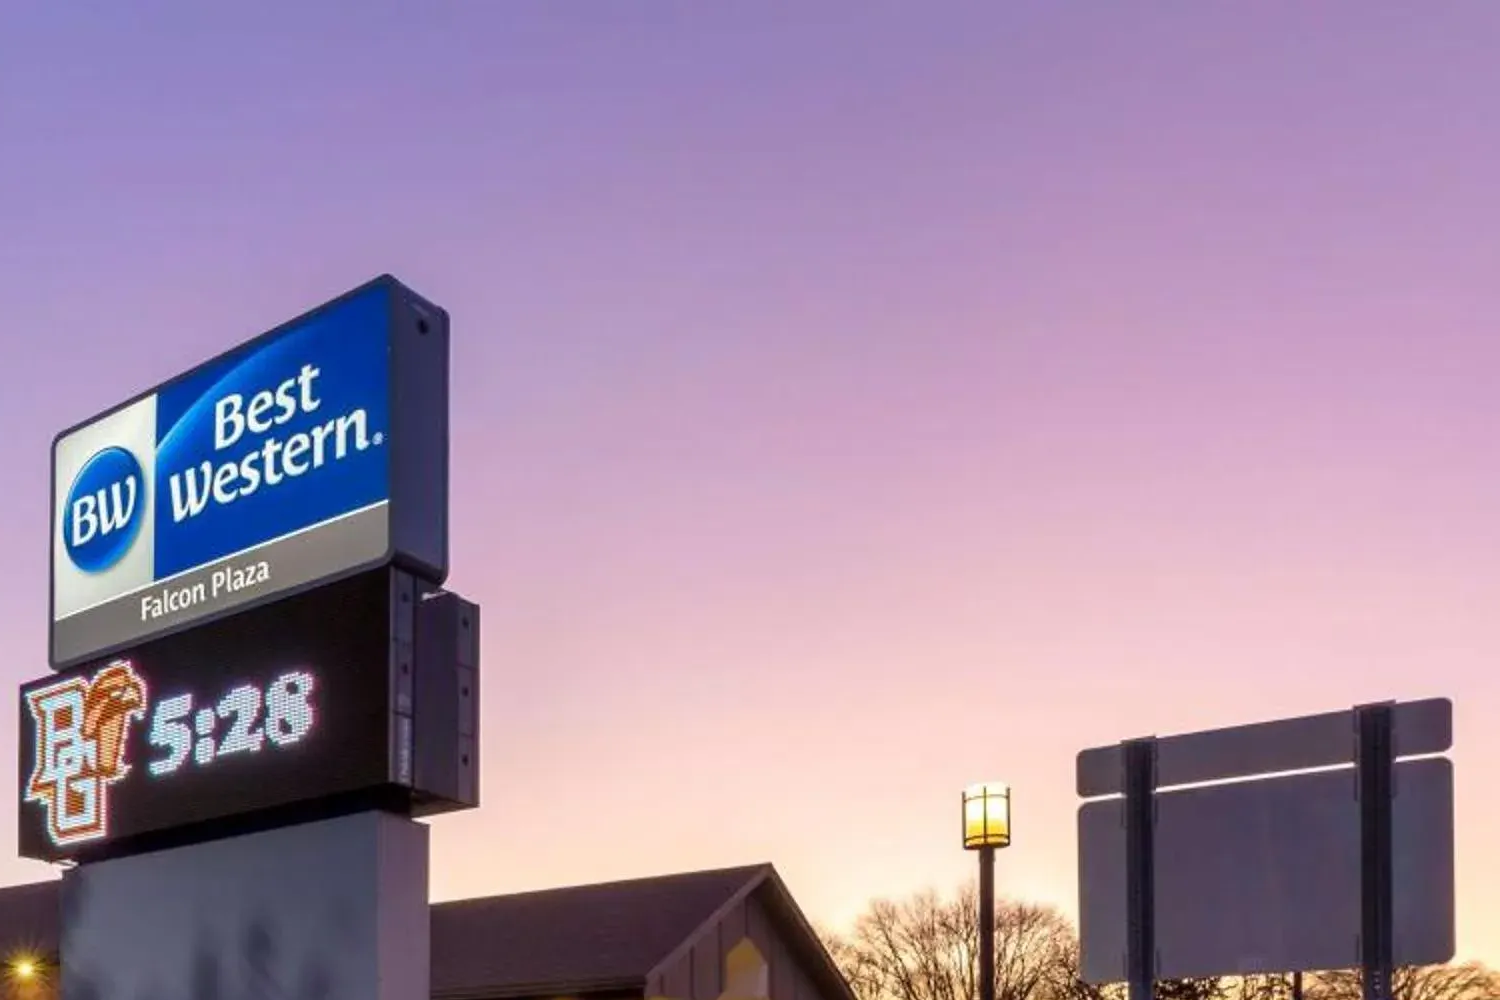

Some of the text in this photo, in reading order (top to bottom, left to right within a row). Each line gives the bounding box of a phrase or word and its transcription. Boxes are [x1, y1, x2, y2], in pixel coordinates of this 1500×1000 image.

[214, 364, 321, 450] Best
[71, 475, 137, 548] BW
[141, 560, 271, 622] Falcon Plaza
[149, 671, 315, 776] 5:28
